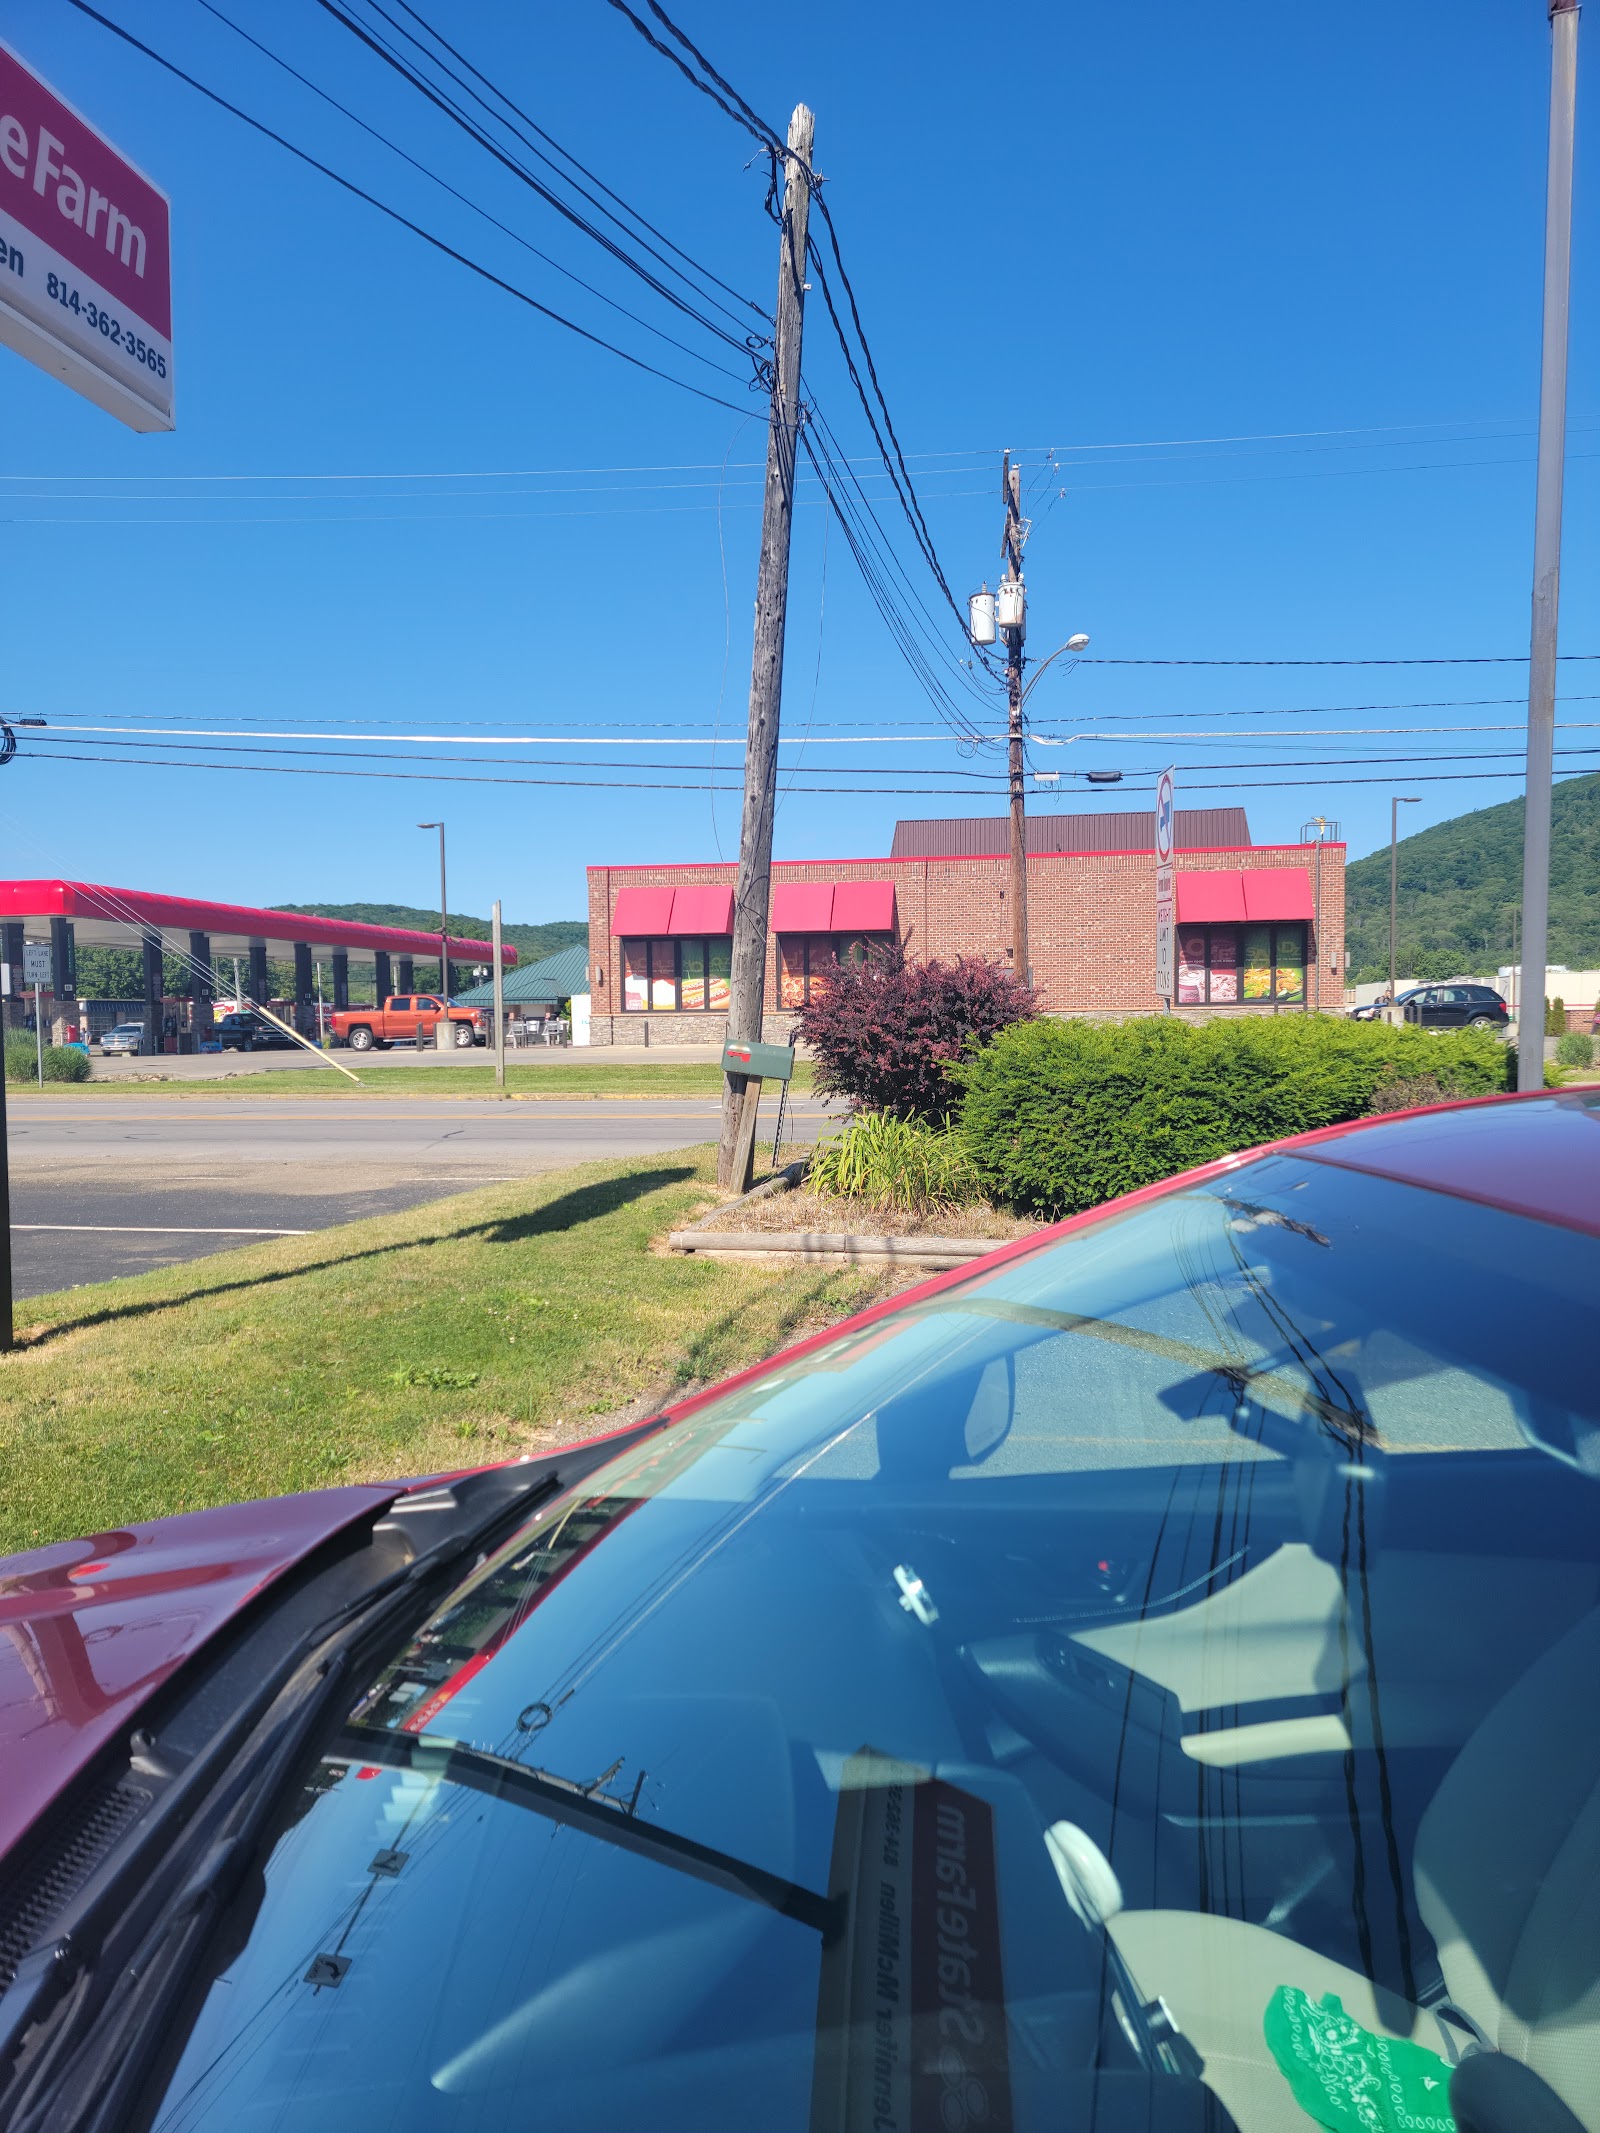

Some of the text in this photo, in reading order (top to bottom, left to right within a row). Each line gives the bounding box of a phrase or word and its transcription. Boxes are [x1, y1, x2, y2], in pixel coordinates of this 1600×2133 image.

[46, 272, 168, 380] 814-362-3565
[26, 949, 37, 957] LEFT
[30, 960, 46, 968] MUST
[39, 971, 50, 979] LEFT
[1157, 970, 1170, 989] TONS
